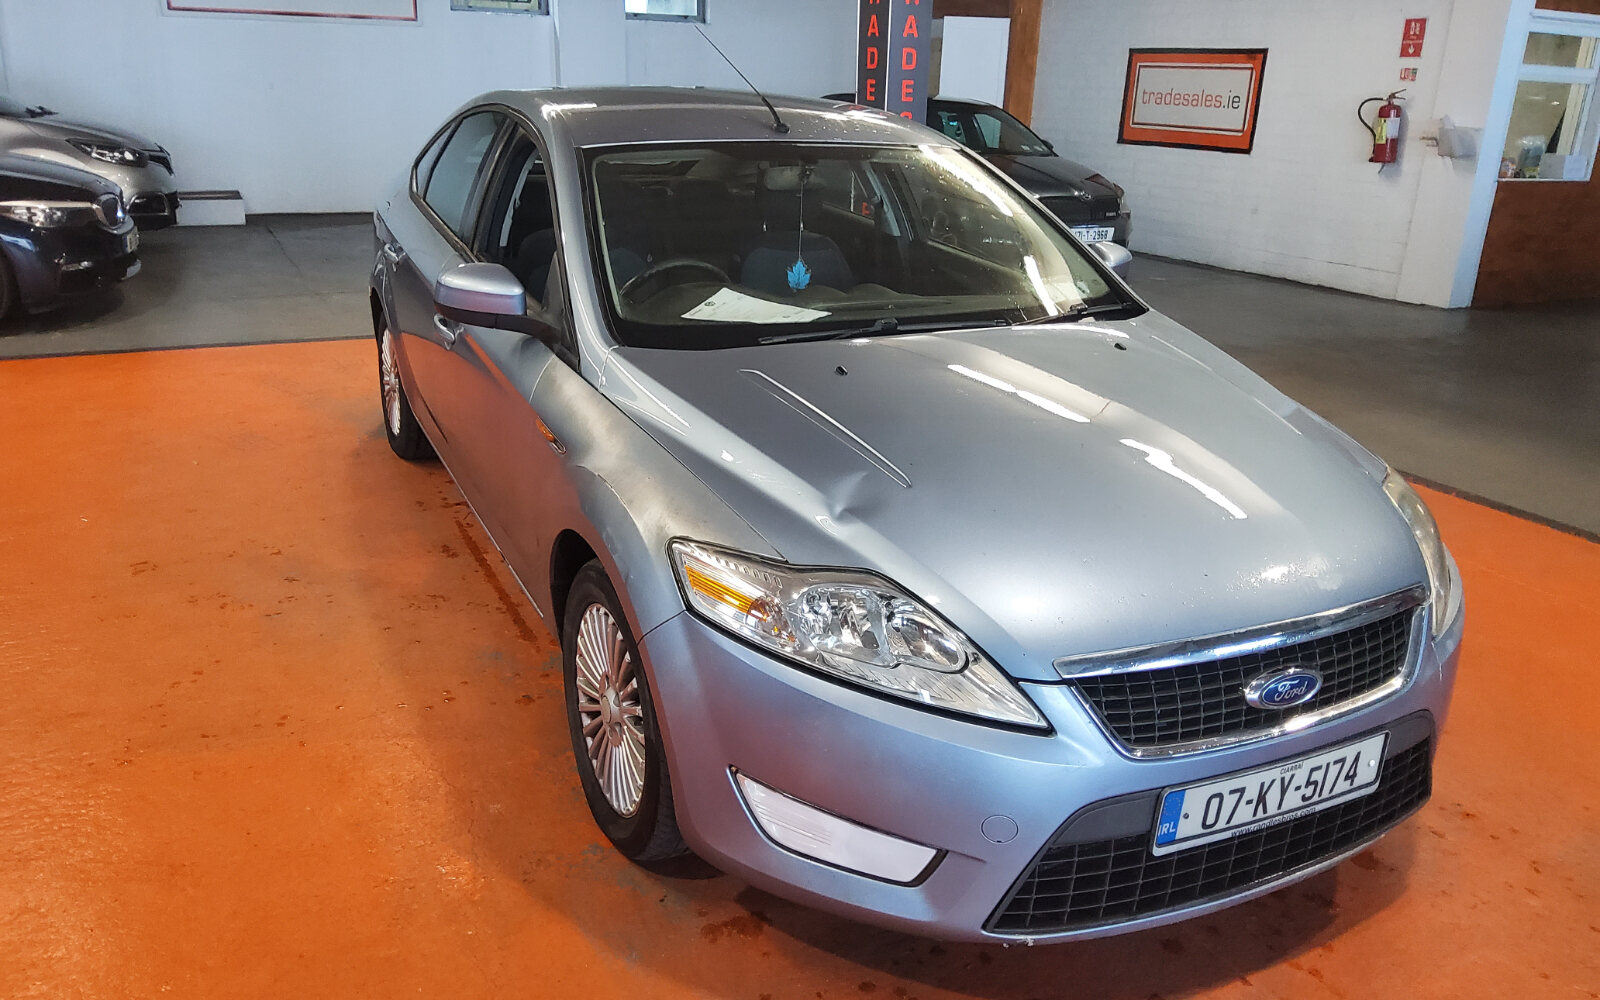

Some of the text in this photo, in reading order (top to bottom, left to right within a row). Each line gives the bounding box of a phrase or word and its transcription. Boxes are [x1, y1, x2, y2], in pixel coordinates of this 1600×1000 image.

[866, 0, 880, 101] ADE
[1142, 88, 1241, 110] tradesales.ie
[1274, 680, 1308, 702] Ford
[1201, 751, 1362, 831] 07-KY-5174
[1157, 821, 1176, 837] IRL
